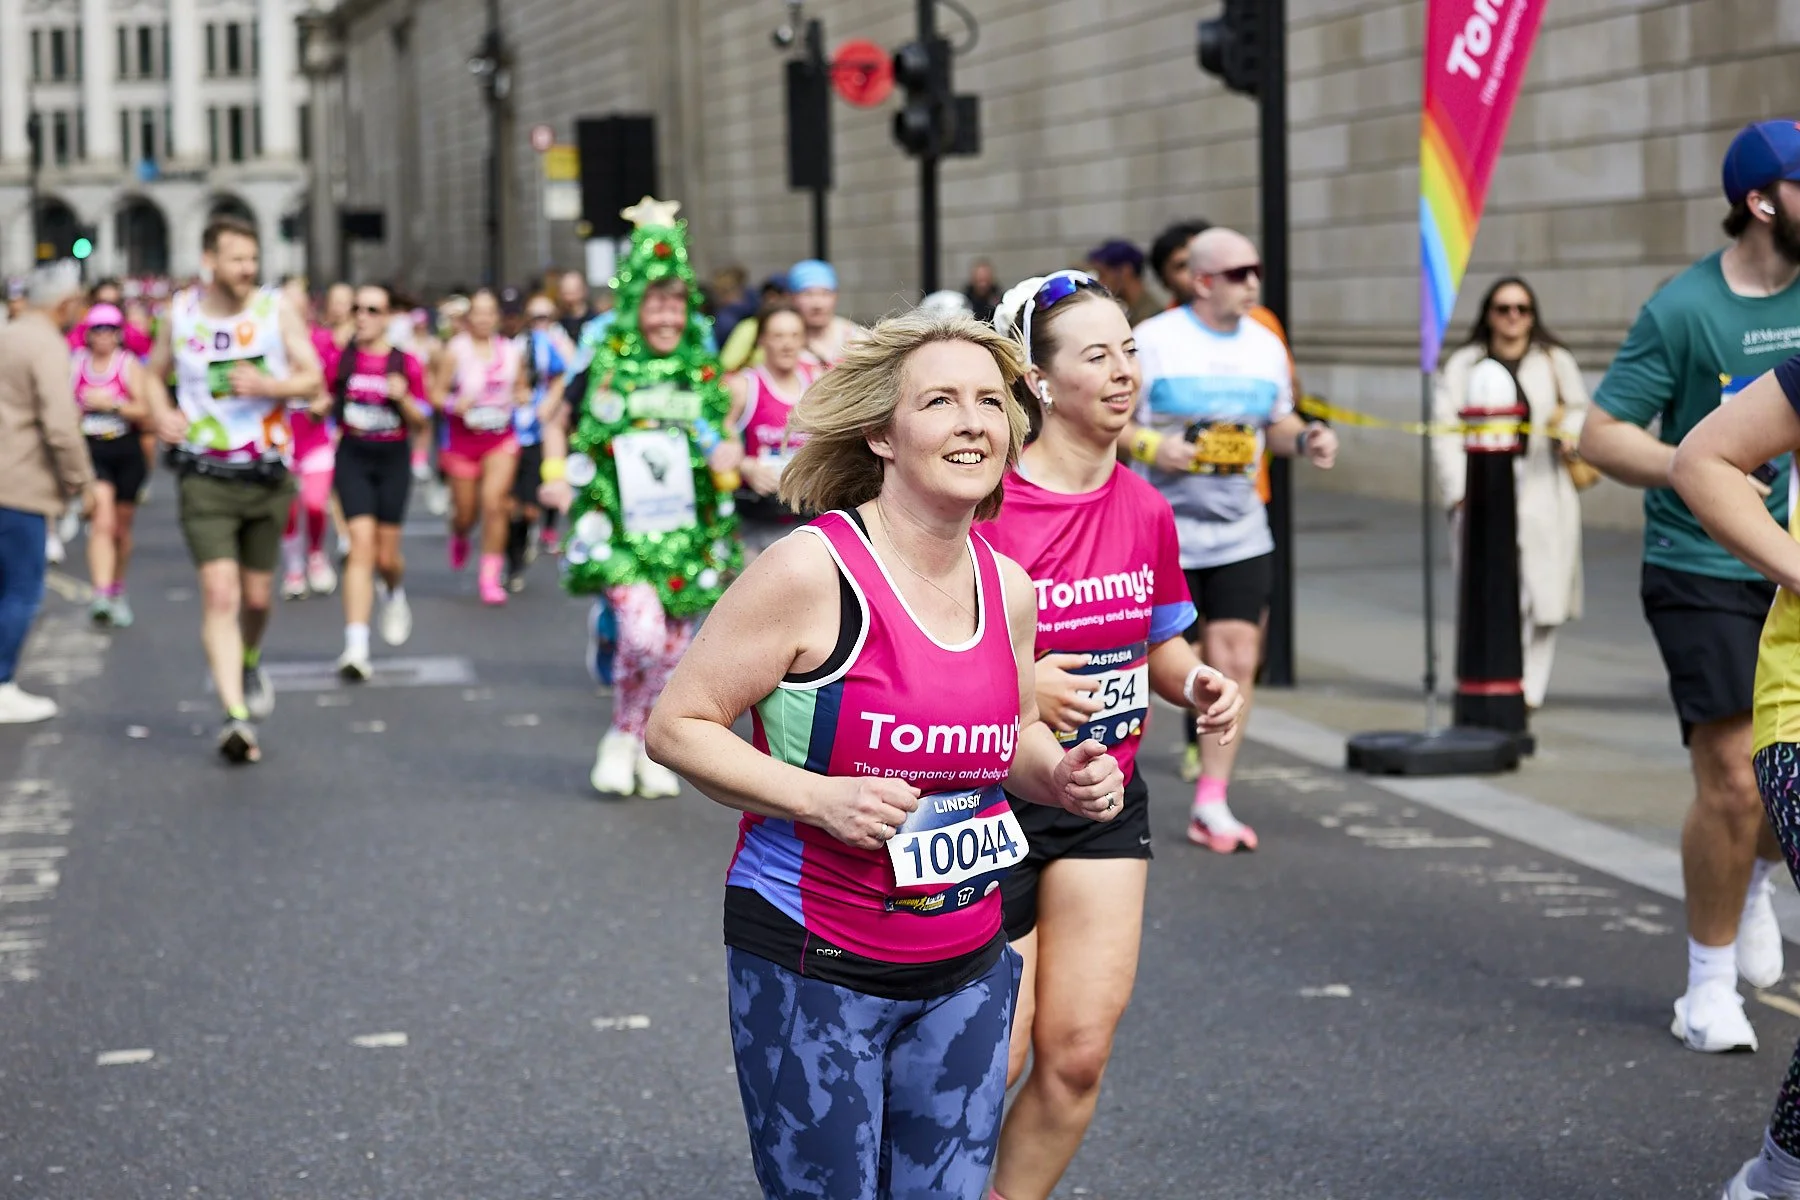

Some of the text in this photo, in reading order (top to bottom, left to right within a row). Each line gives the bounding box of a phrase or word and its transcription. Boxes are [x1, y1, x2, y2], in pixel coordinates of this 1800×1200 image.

[1034, 563, 1154, 610] Tommy's
[1054, 615, 1104, 632] pregnancy
[1106, 609, 1124, 622] and
[1088, 650, 1133, 665] ASTASIA
[854, 762, 880, 775] The
[884, 767, 955, 780] pregnancy
[959, 767, 981, 779] and
[982, 767, 1001, 780] baby
[903, 820, 1018, 878] 10044
